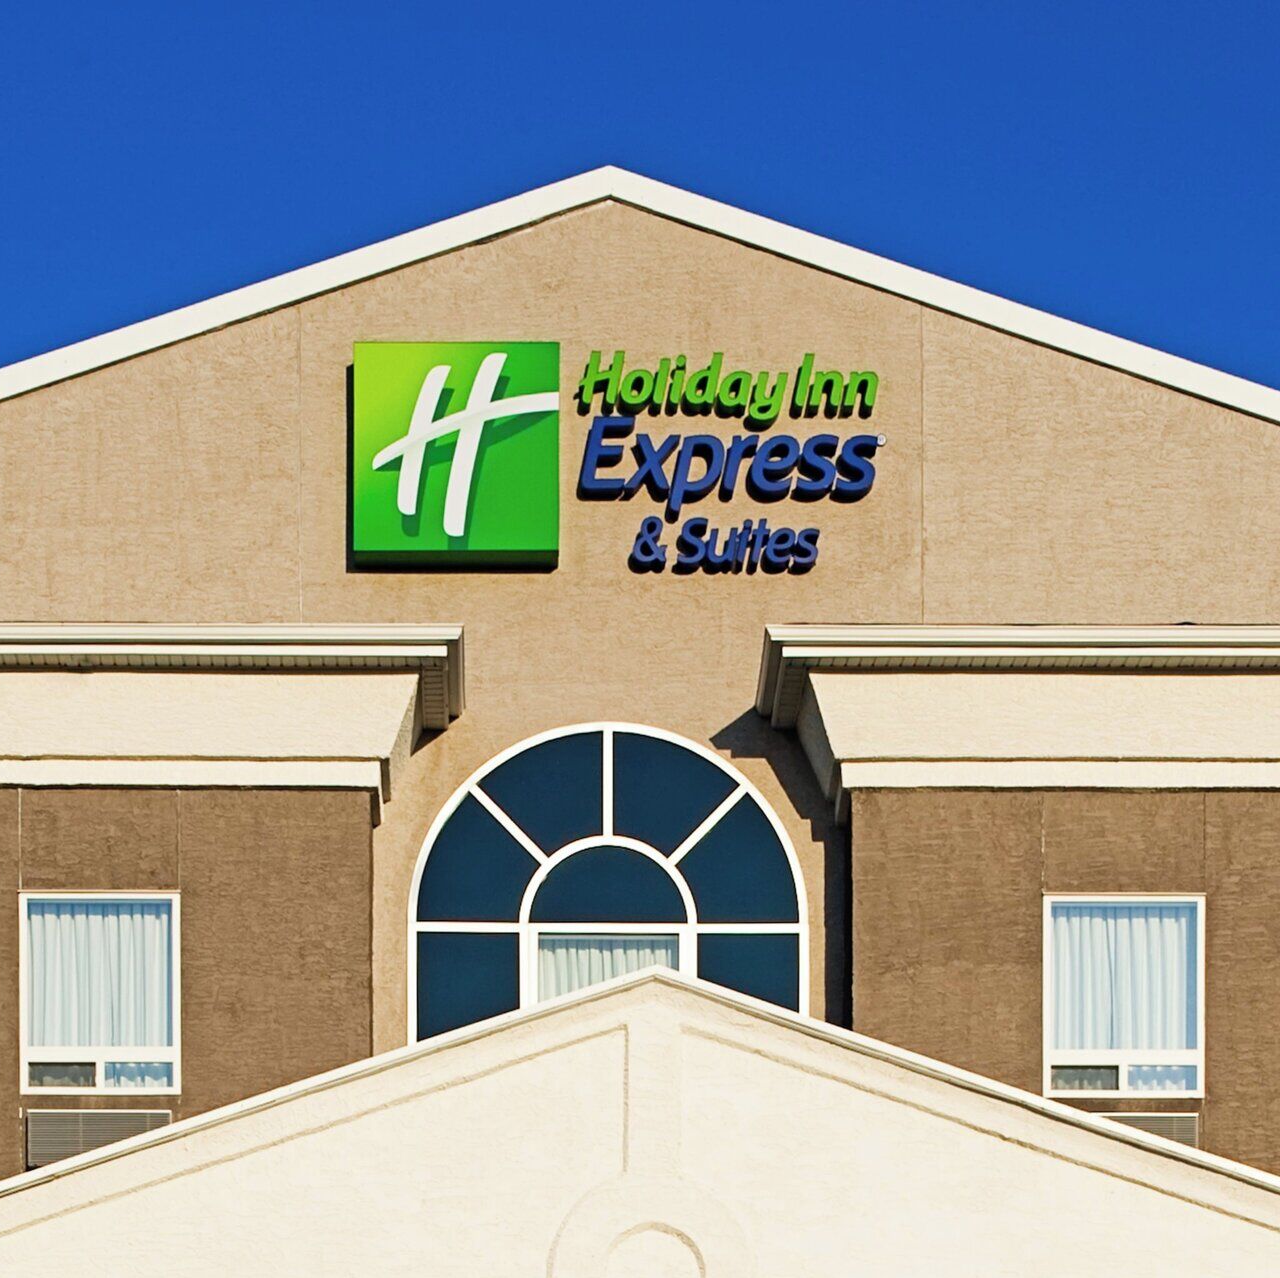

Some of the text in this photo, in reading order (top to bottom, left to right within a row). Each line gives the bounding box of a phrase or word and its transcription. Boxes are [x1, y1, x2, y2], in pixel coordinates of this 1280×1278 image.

[578, 350, 879, 422] Holiday Inn
[579, 416, 878, 516] Express
[632, 517, 820, 566] & Suites
